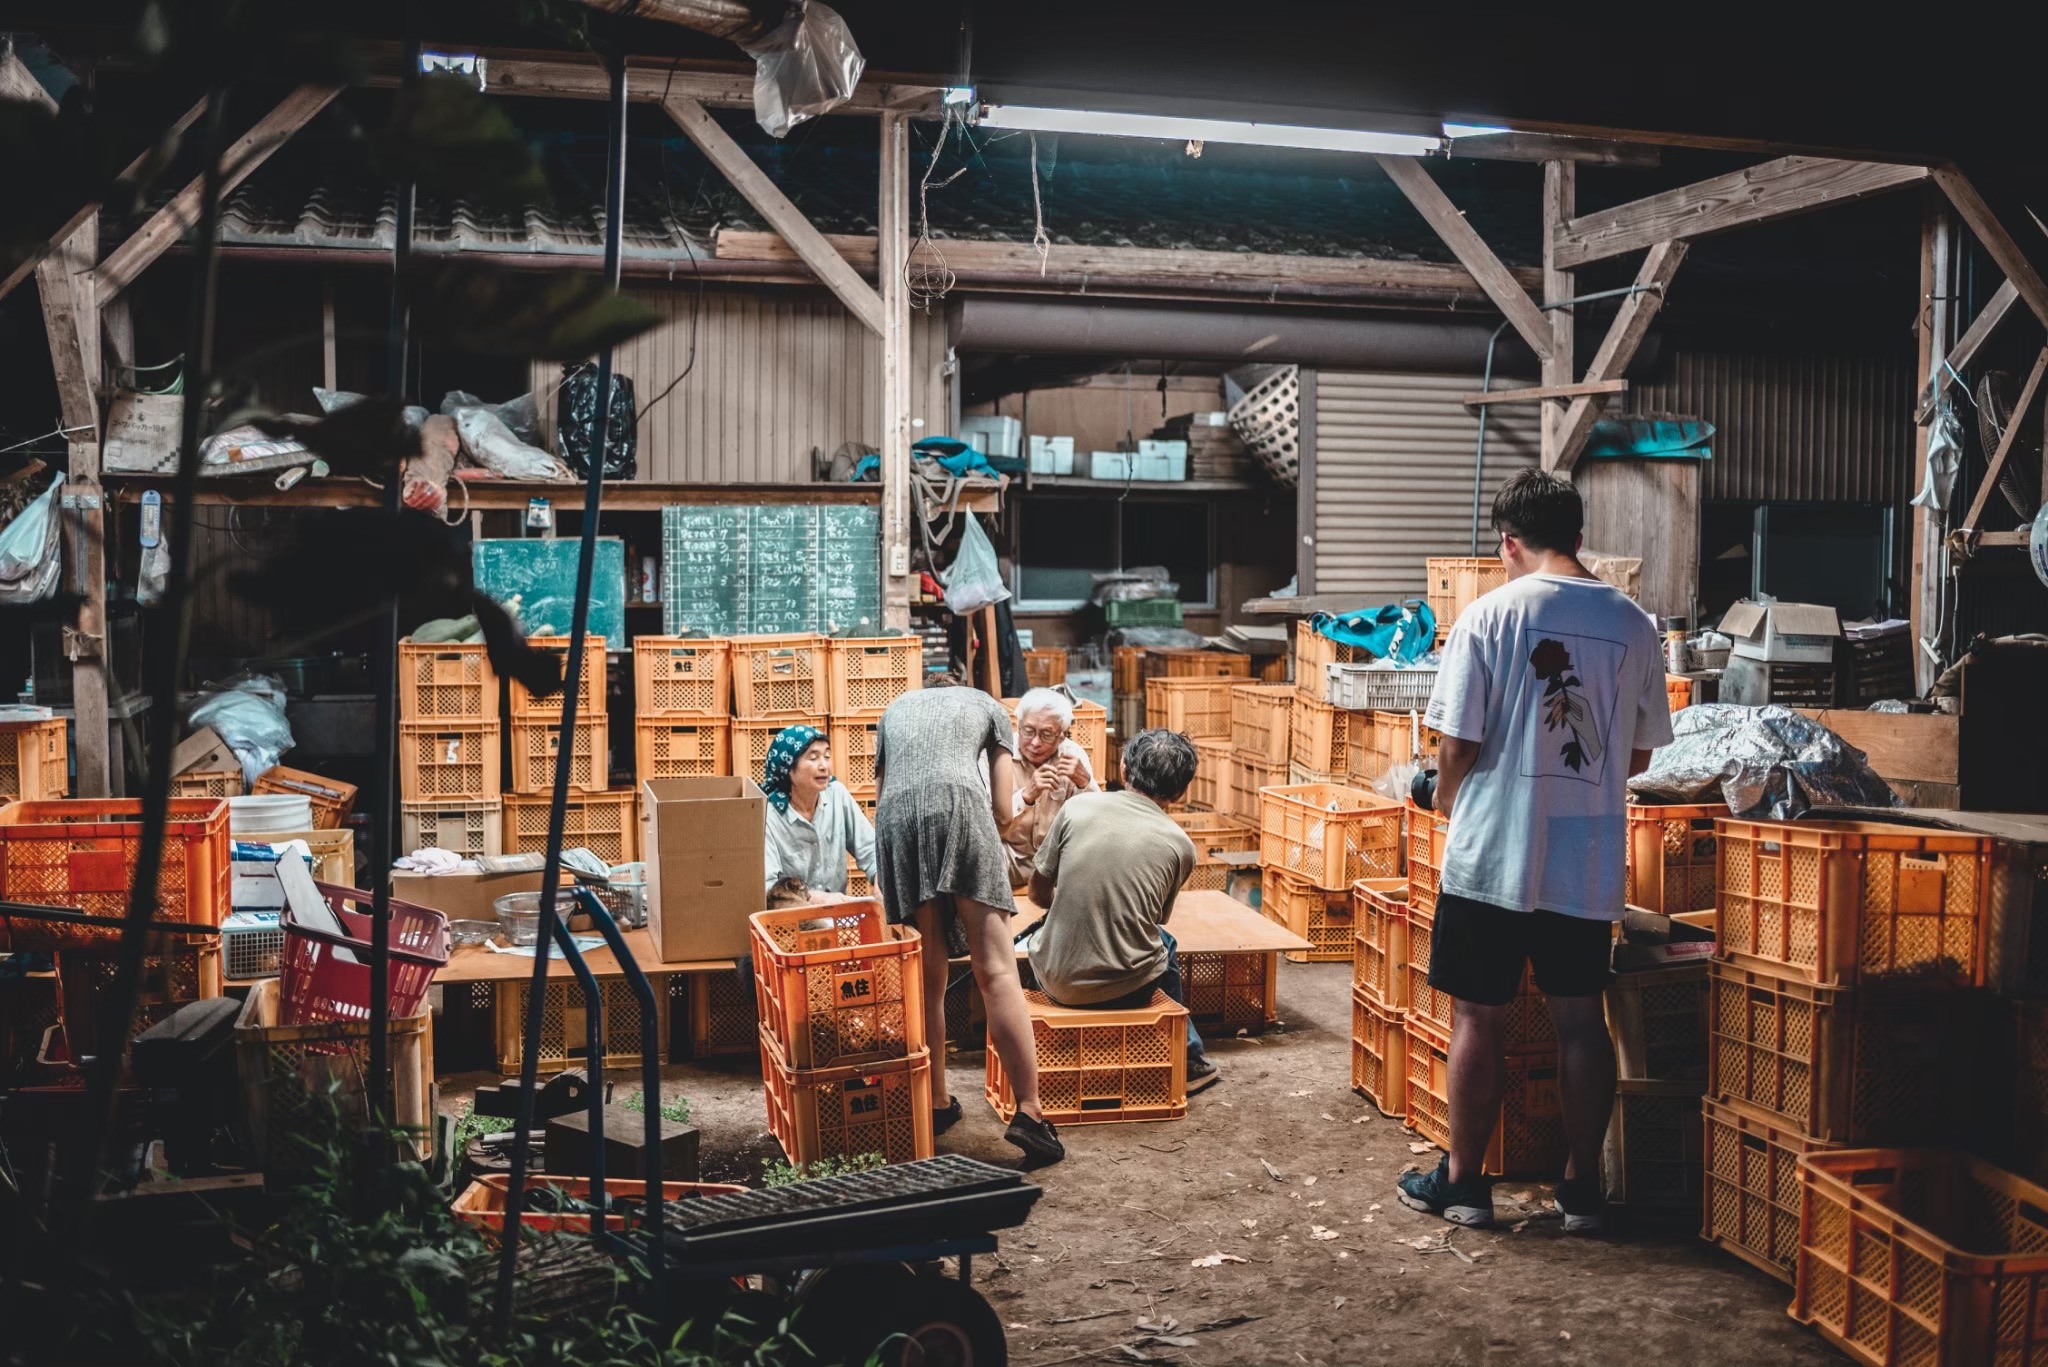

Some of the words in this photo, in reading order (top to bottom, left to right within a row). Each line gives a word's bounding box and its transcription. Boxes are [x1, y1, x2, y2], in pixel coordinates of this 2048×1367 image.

[674, 661, 693, 673] 魚住
[840, 978, 870, 999] 魚住
[850, 1094, 880, 1115] 魚住
